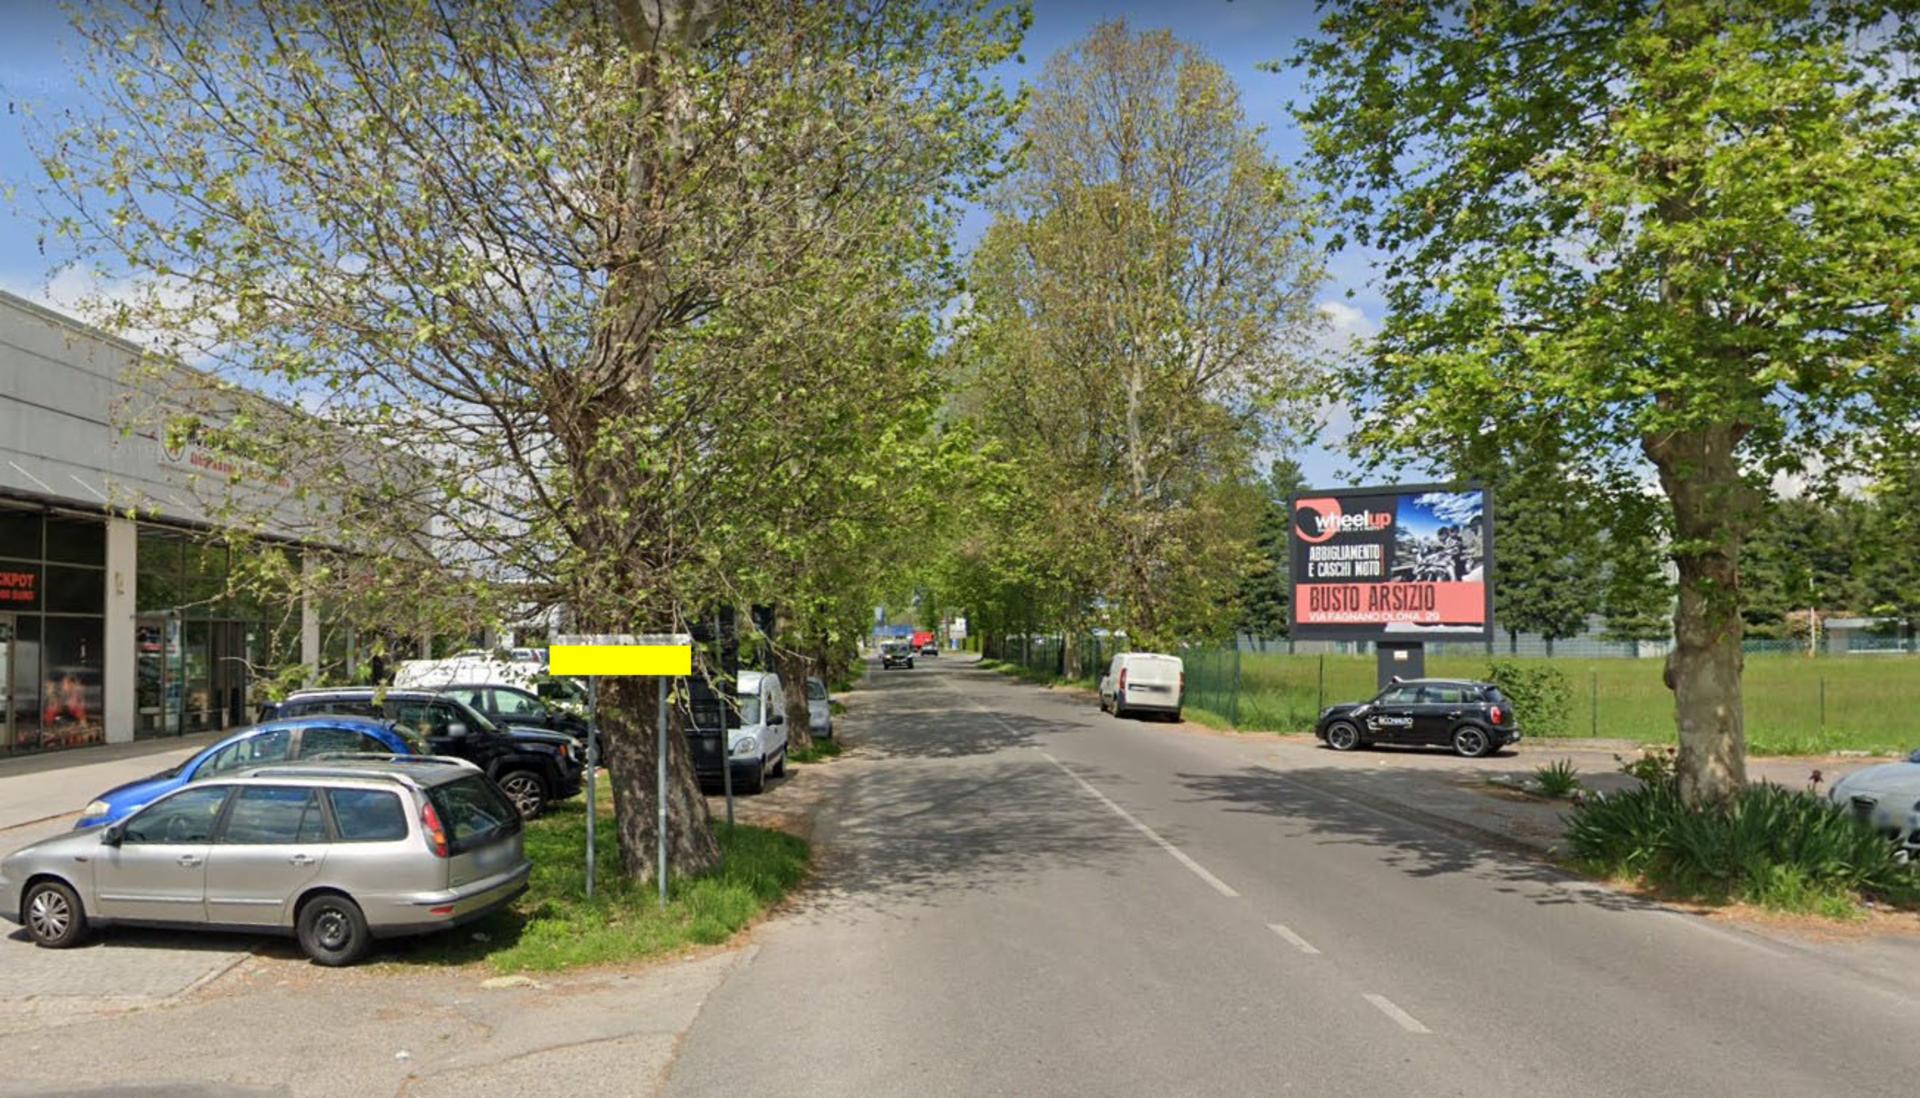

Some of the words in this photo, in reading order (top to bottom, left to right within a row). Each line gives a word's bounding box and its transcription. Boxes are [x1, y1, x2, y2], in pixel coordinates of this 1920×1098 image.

[1315, 510, 1391, 528] wheelup
[1309, 544, 1380, 561] ABBIGLIAMENTO
[1308, 563, 1314, 577] E
[1317, 561, 1351, 577] CASCHI
[1354, 560, 1380, 576] MOTO
[1309, 585, 1360, 612] BUSTO
[1368, 584, 1435, 612] ARSIZIO
[1310, 613, 1325, 622] VIA
